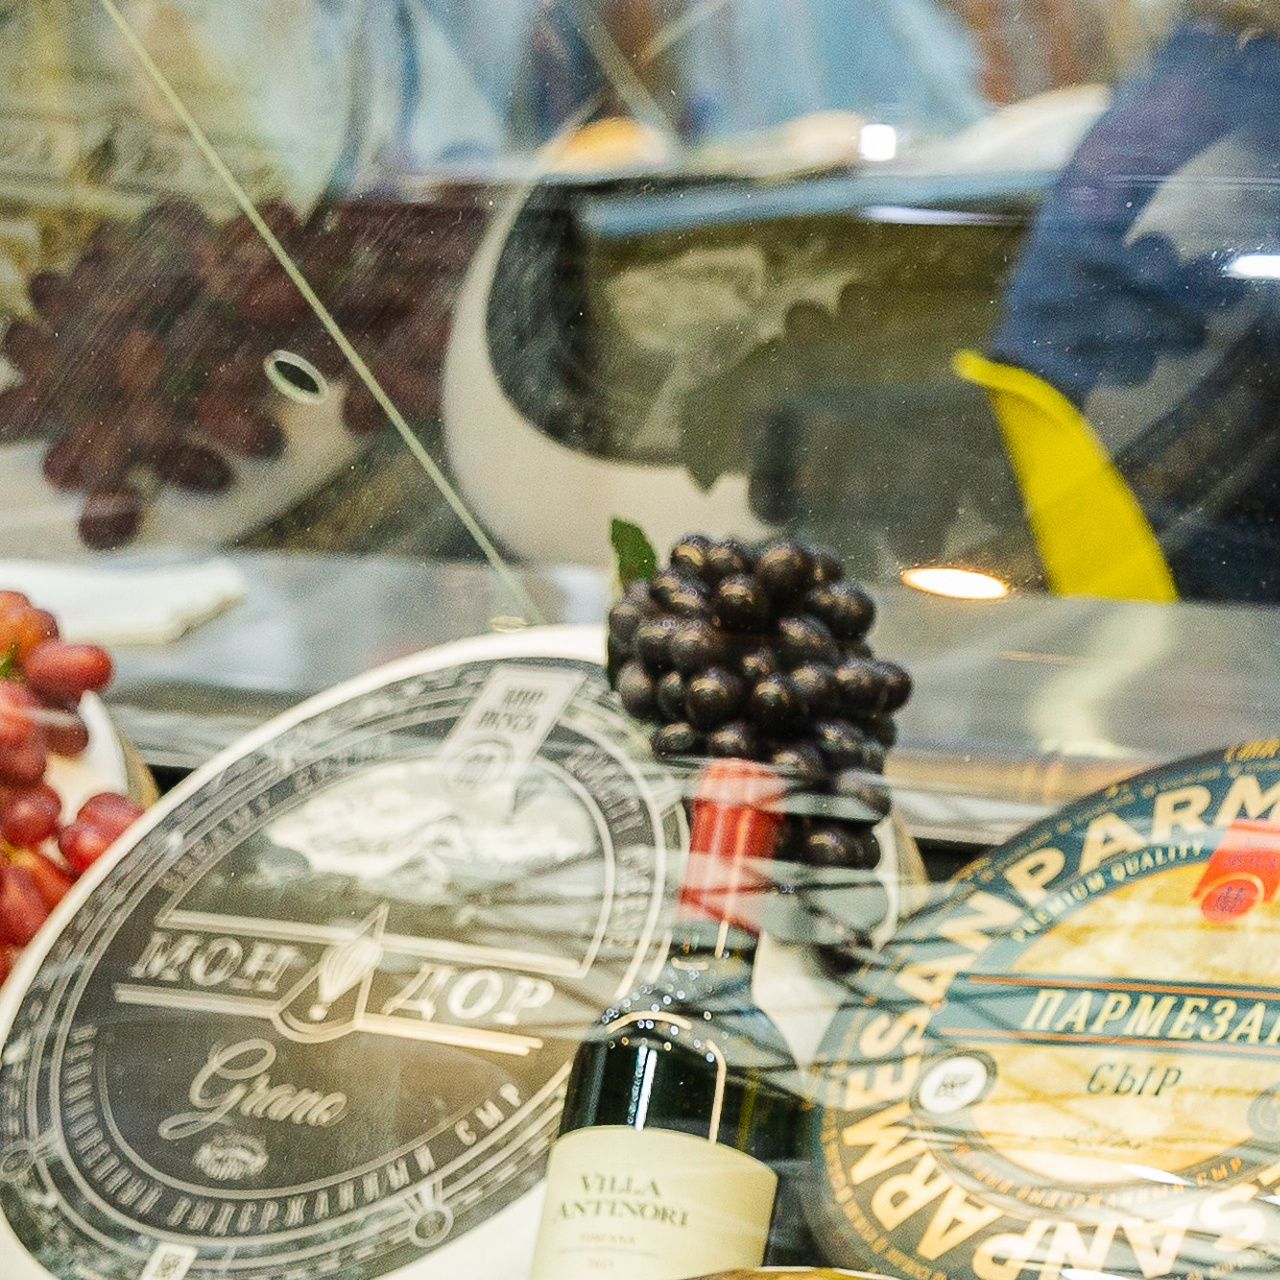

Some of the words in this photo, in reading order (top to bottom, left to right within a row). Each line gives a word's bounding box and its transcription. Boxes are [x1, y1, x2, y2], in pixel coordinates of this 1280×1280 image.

[131, 931, 298, 992] МОН
[380, 964, 556, 1026] ДОР
[1087, 1061, 1184, 1098] СЫР
[579, 1173, 662, 1199] VILLA
[552, 1200, 690, 1227] ANTINORI
